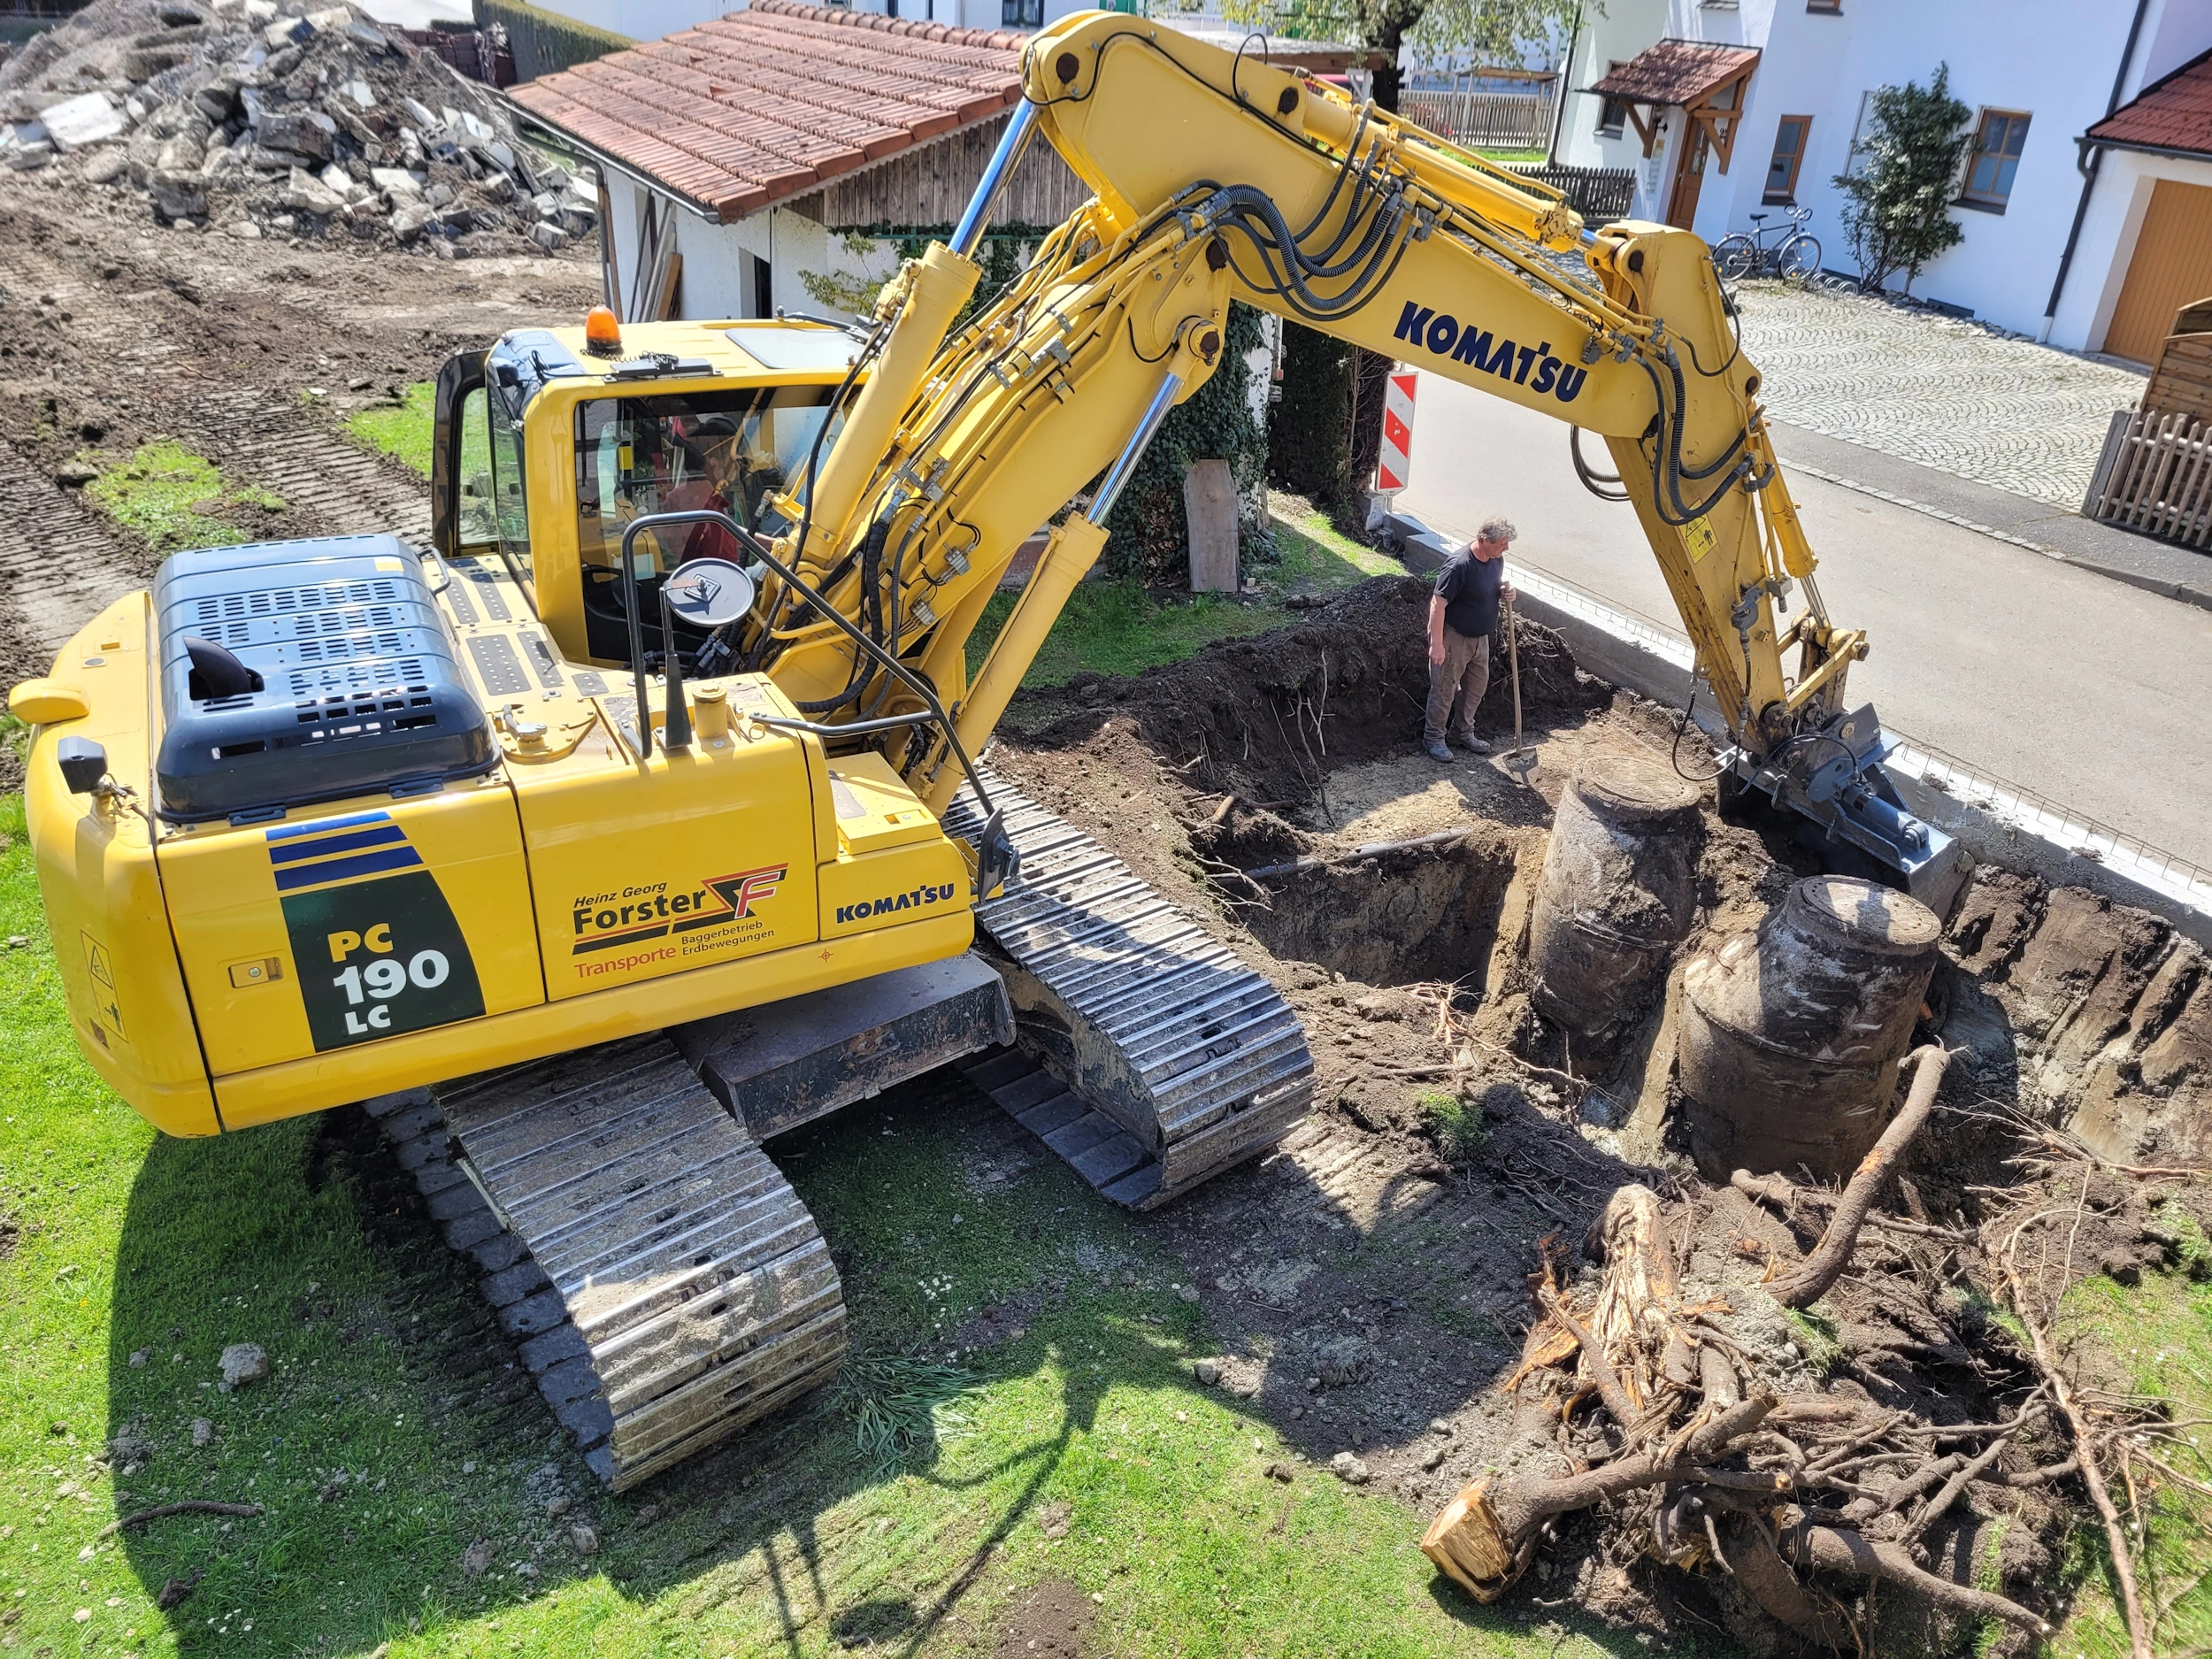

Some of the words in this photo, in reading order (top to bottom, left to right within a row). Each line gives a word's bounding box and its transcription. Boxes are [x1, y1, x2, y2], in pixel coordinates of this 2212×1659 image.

[1393, 300, 1588, 403] KOMATSU
[572, 889, 706, 935] Forster
[573, 892, 618, 908] Heinz
[622, 881, 667, 898] Georg
[836, 883, 955, 924] KOMATSU
[327, 923, 394, 963] PC
[681, 920, 763, 945] Baggerbetrieb
[682, 930, 775, 956] Erdbewegungen
[333, 949, 449, 1005] 190
[573, 947, 677, 979] Transporte
[344, 1005, 391, 1035] LC
